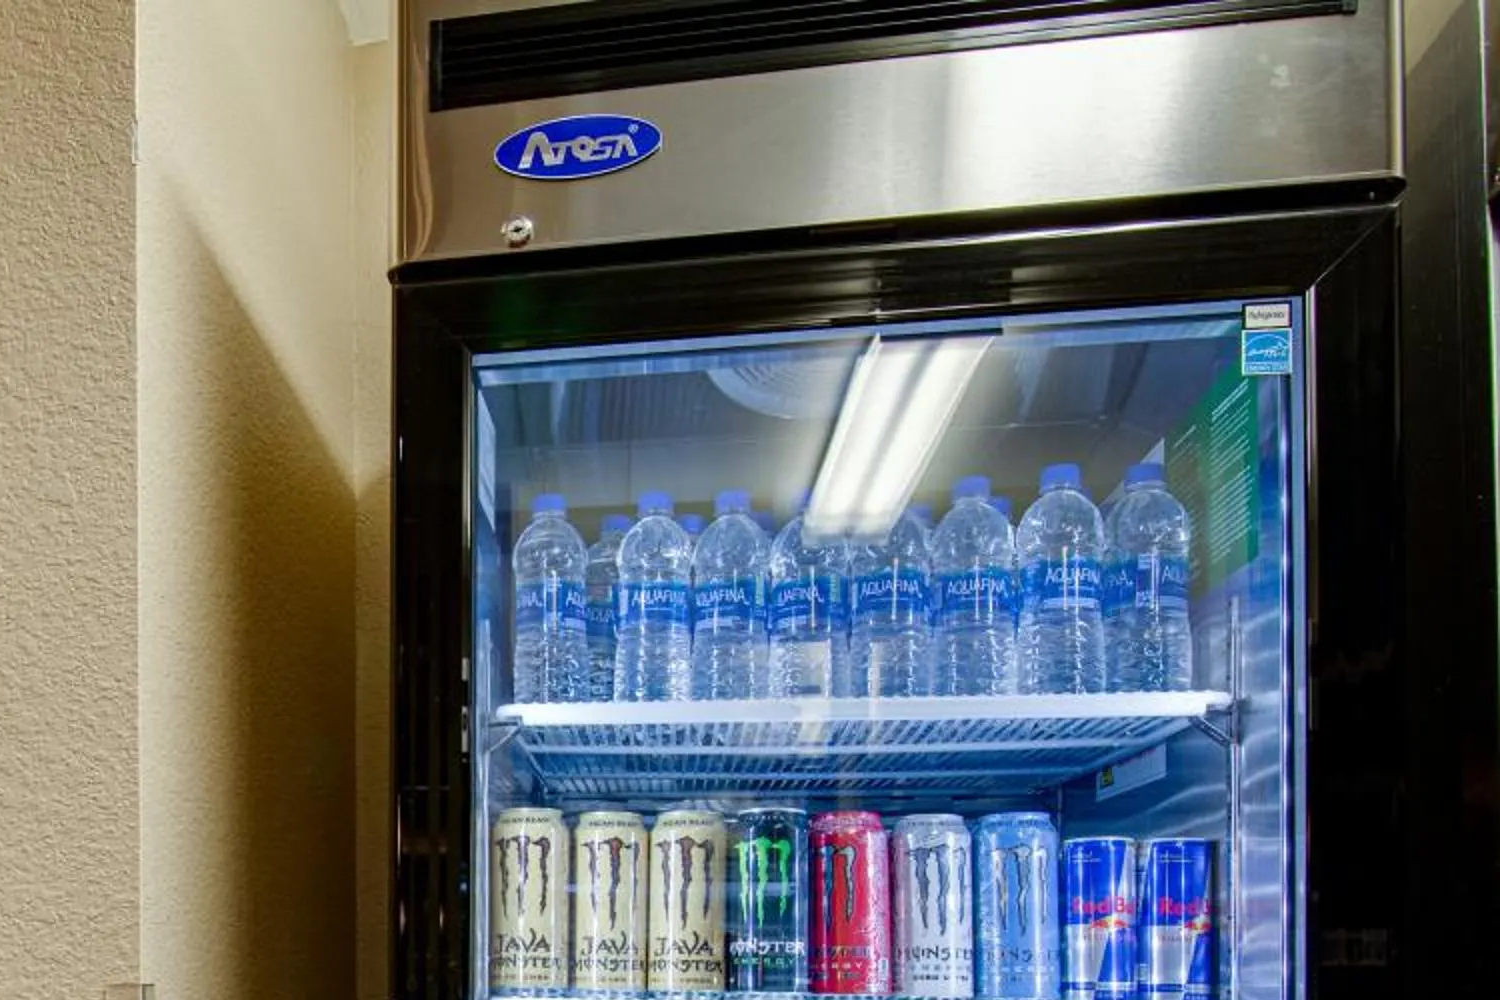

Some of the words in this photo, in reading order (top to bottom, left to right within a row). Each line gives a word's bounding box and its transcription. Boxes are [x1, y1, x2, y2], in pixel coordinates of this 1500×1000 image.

[494, 927, 550, 953] JAVA
[580, 930, 639, 957] JAVA
[653, 930, 714, 957] JAVA
